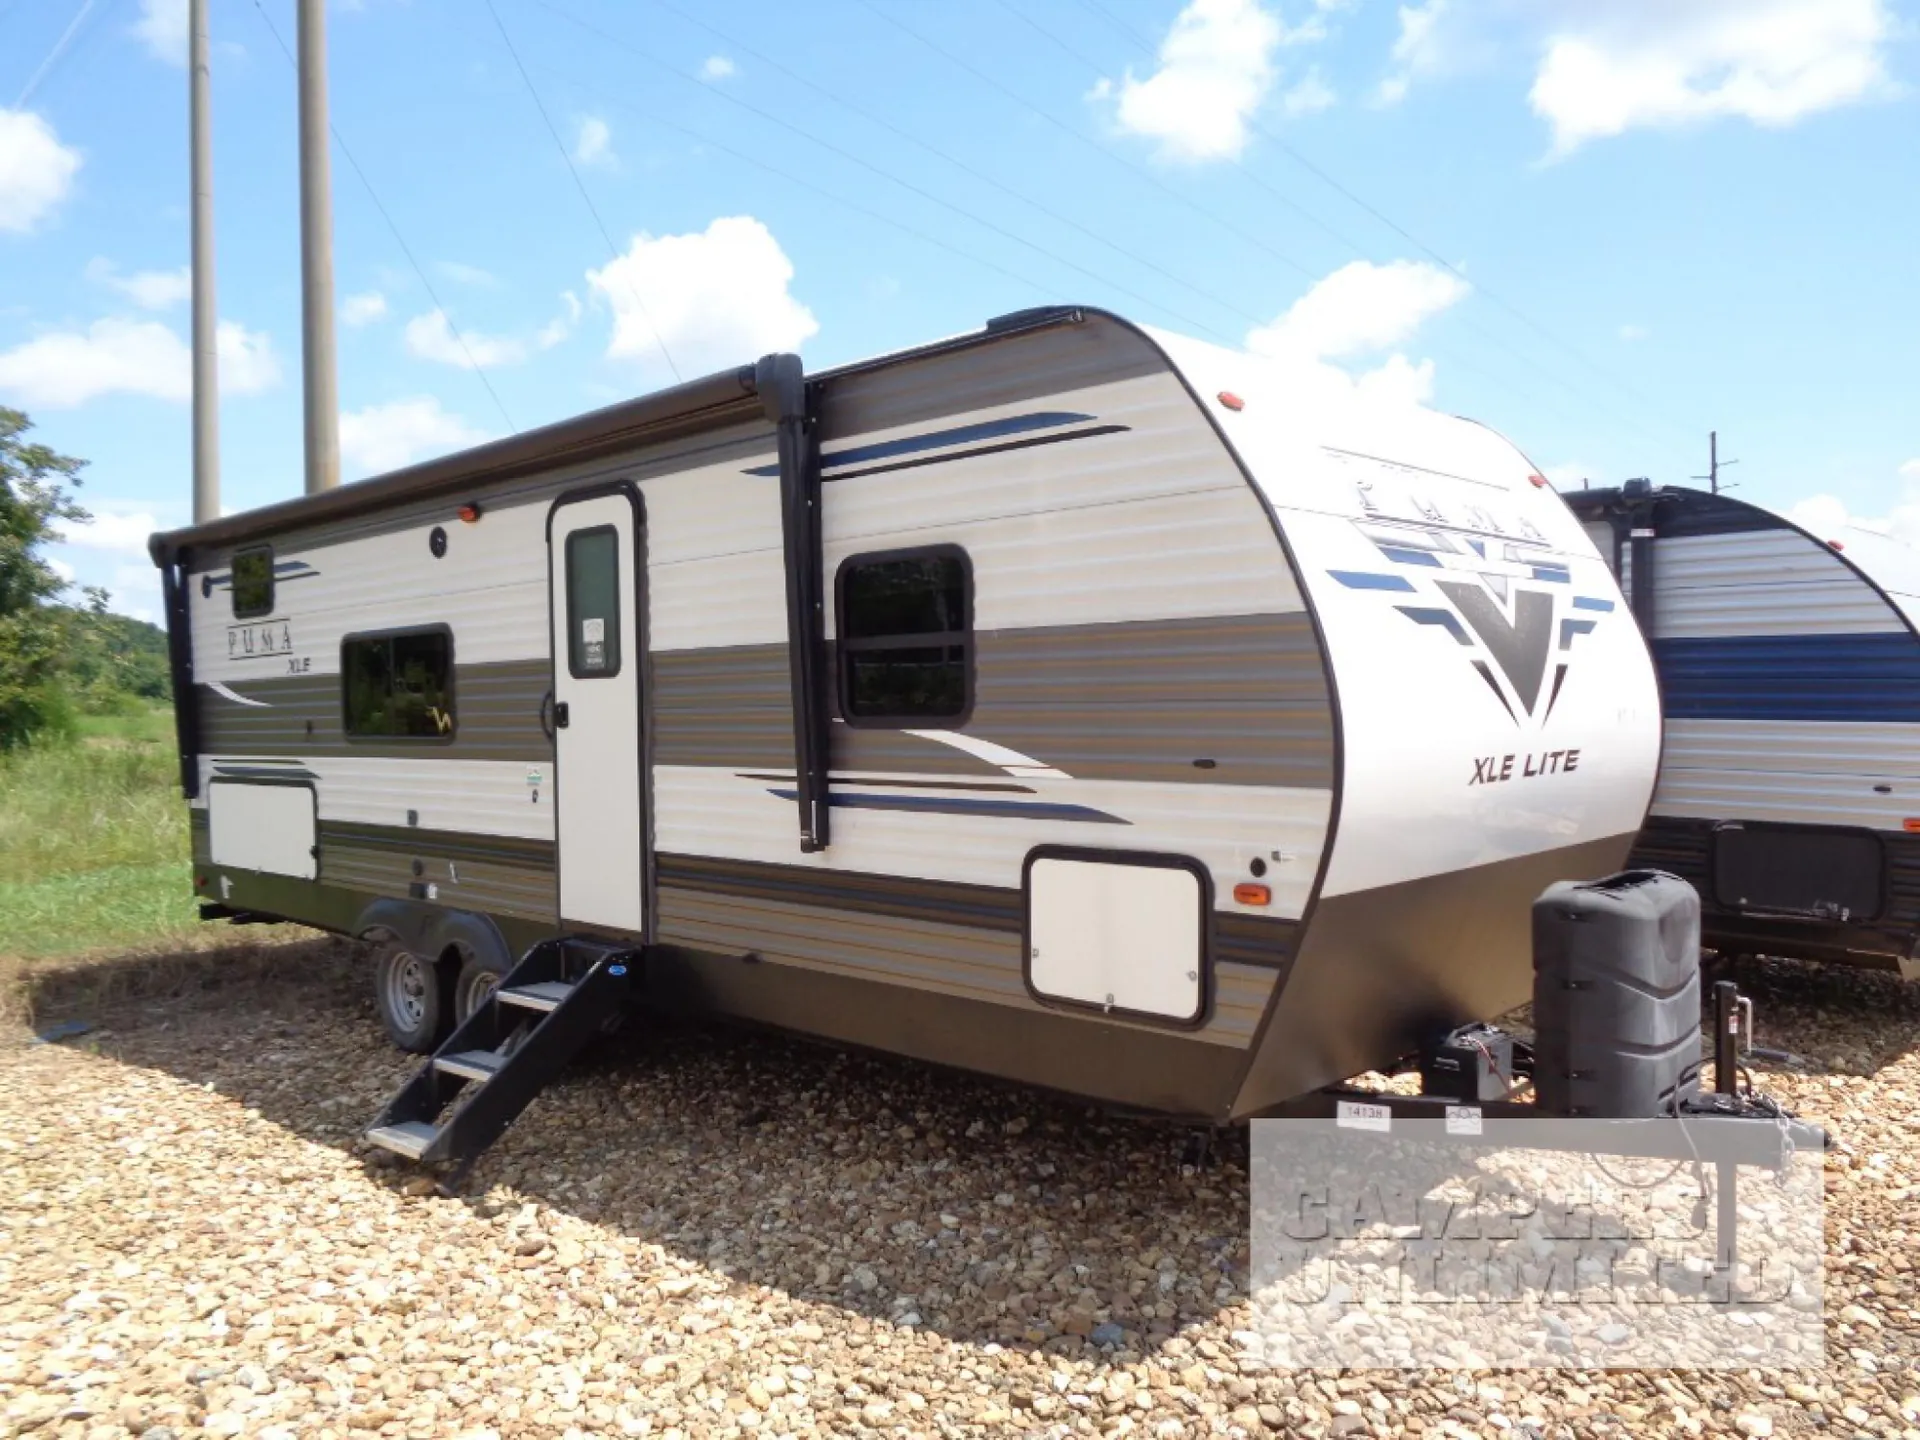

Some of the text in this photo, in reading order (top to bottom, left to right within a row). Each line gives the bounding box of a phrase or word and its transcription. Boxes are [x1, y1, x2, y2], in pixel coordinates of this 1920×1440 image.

[228, 623, 292, 655] PUMA
[1468, 749, 1580, 786] XLE LITE
